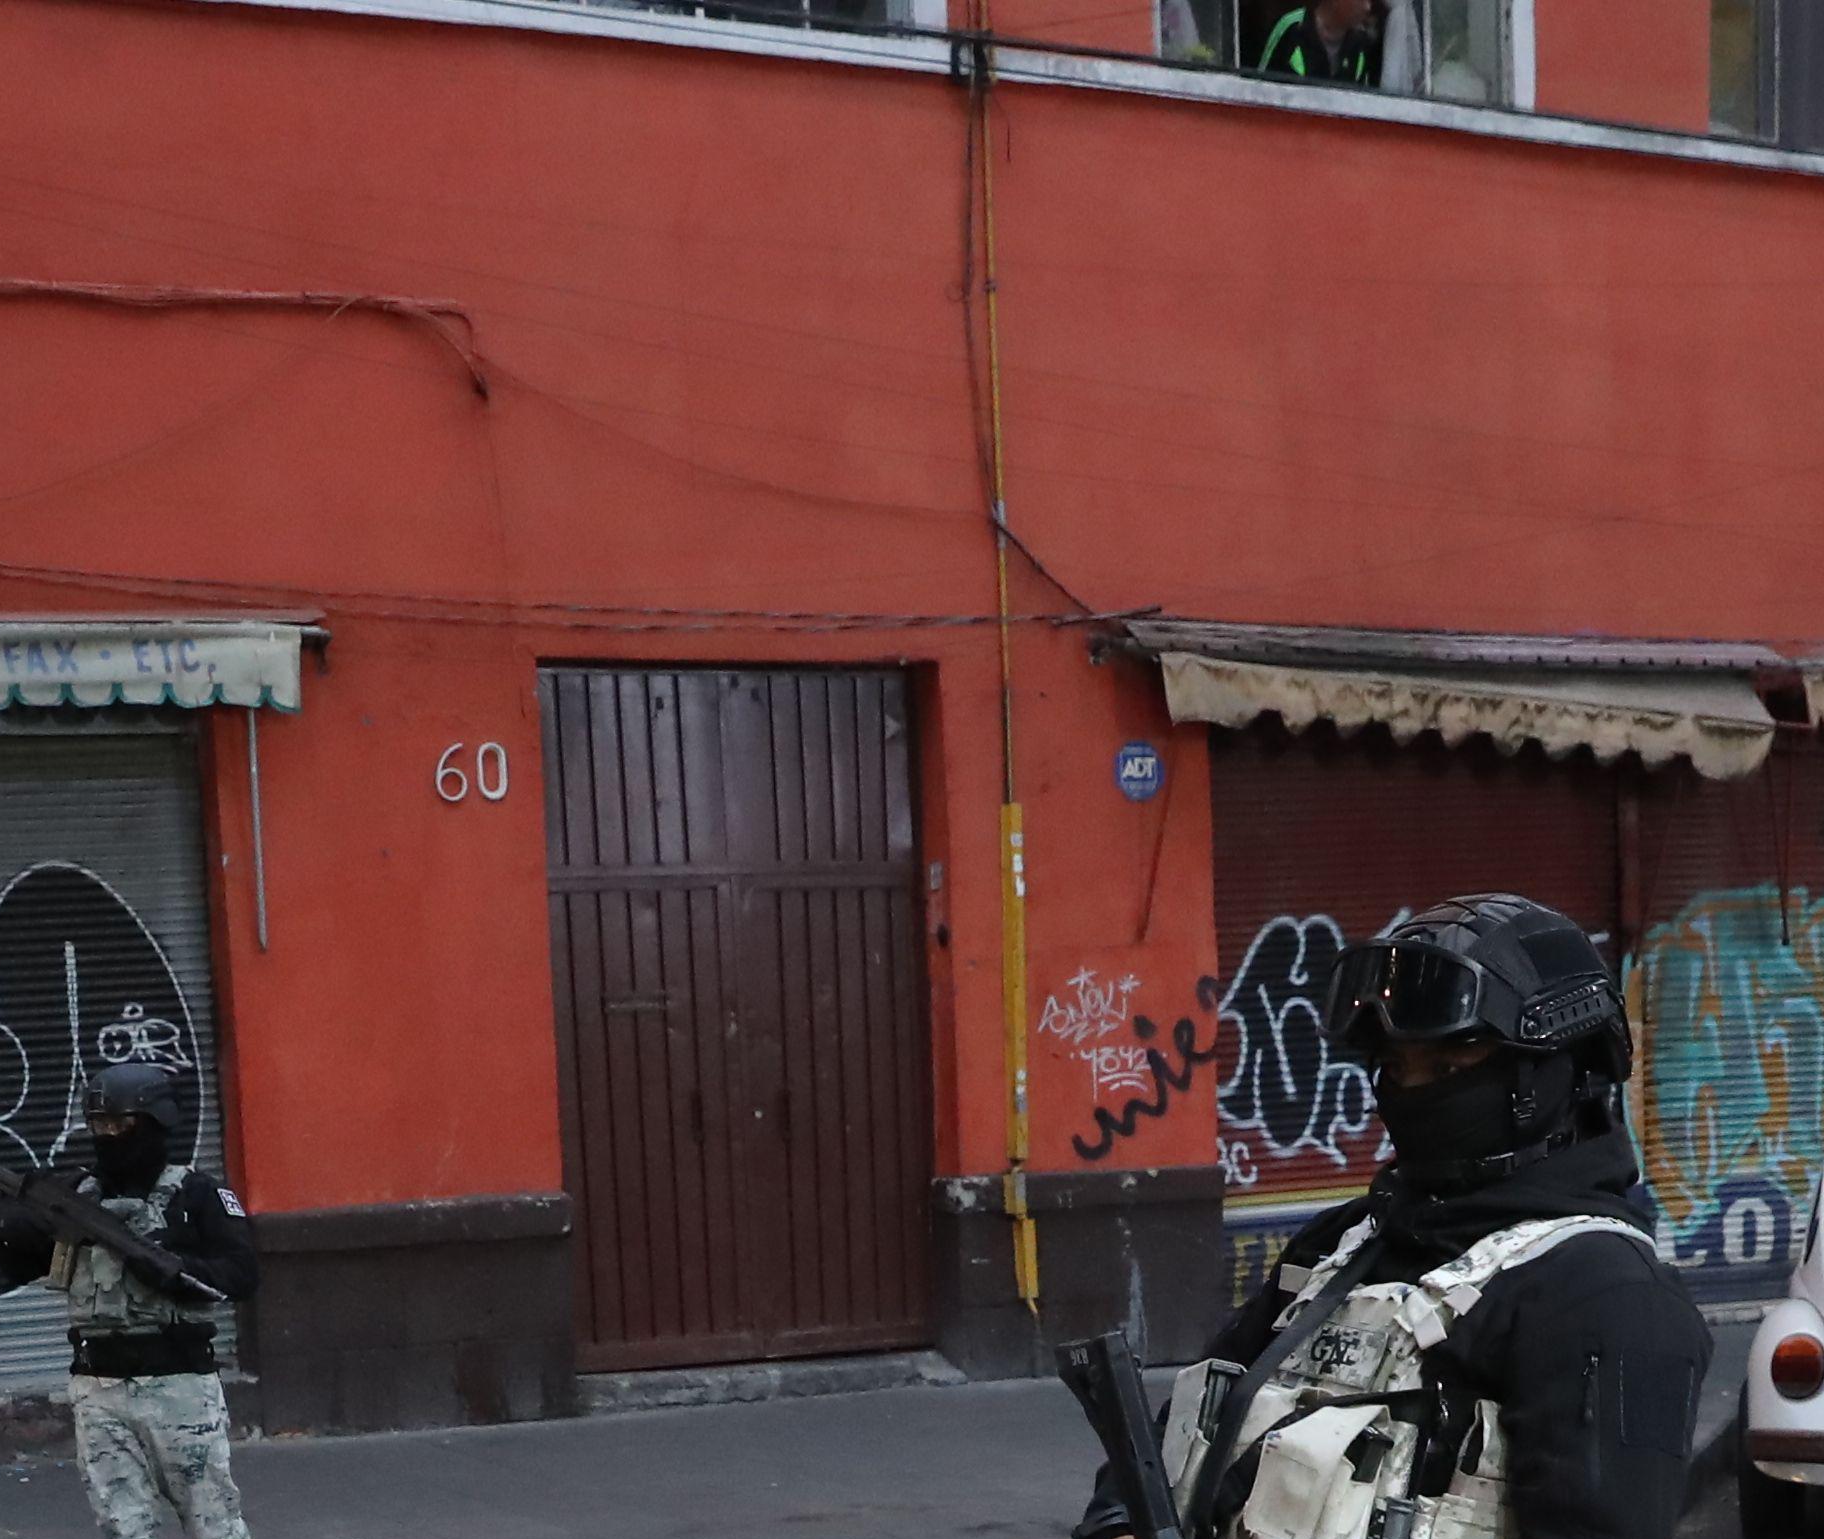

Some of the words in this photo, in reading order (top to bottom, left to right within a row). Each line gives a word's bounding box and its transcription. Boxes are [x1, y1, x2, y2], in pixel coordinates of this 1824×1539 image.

[3, 641, 78, 674] FAX
[436, 742, 508, 801] 60
[1121, 757, 1156, 778] ADT
